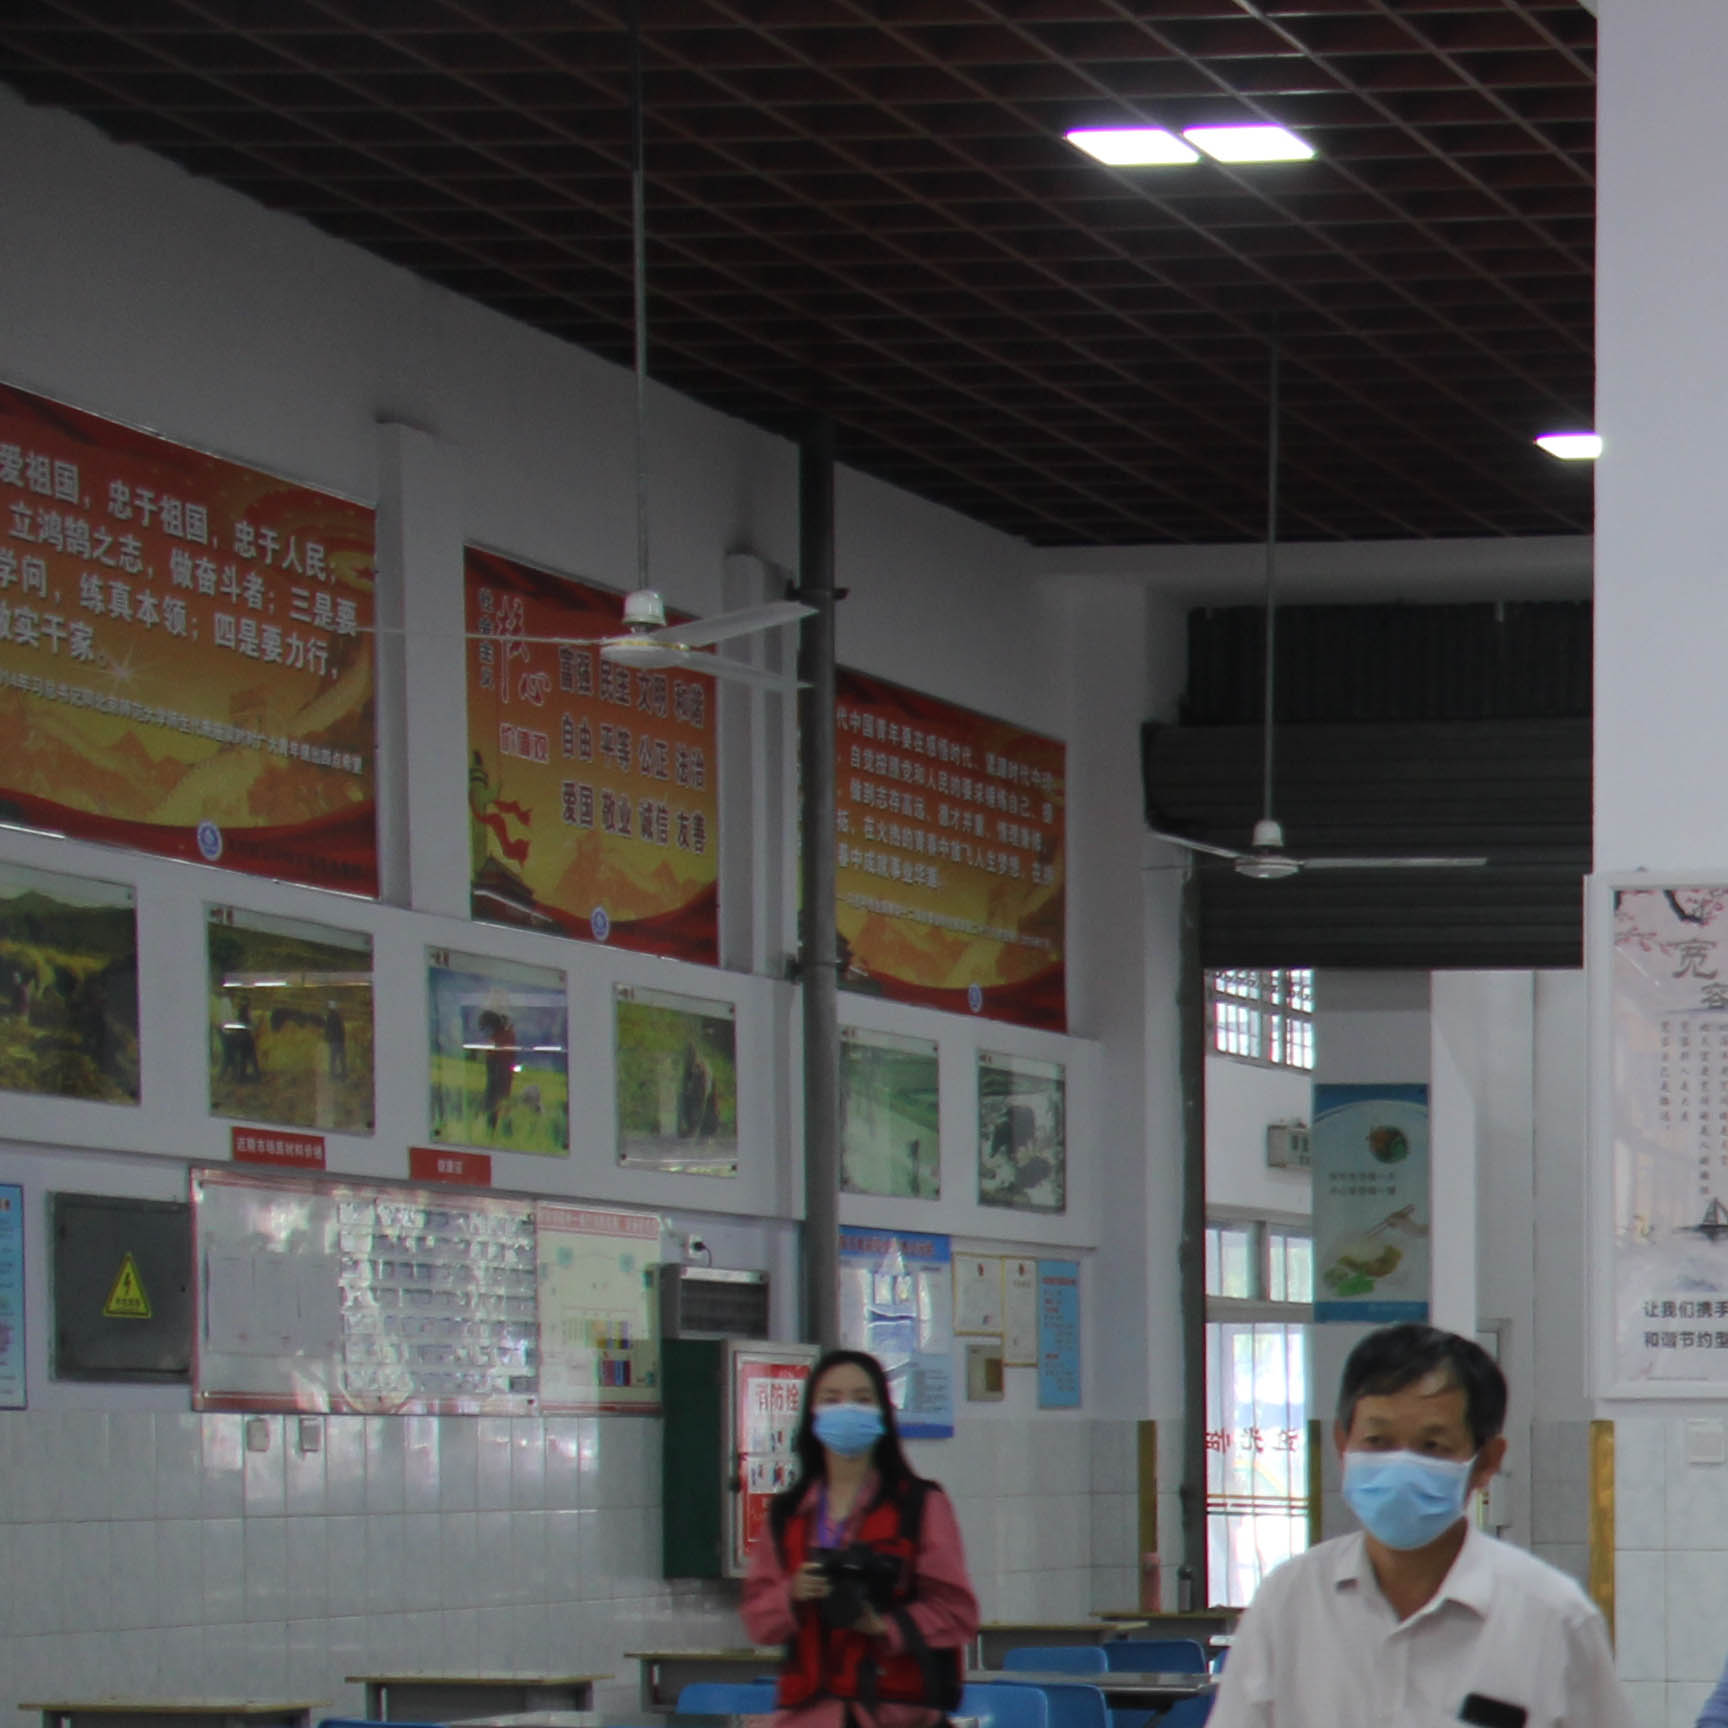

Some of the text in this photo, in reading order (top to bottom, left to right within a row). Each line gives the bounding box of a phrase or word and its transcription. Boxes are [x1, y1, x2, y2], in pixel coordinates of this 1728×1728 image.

[561, 712, 705, 791] 自由 平等 公正 法治
[561, 780, 706, 854] 爱国 敬业 诚信 友善
